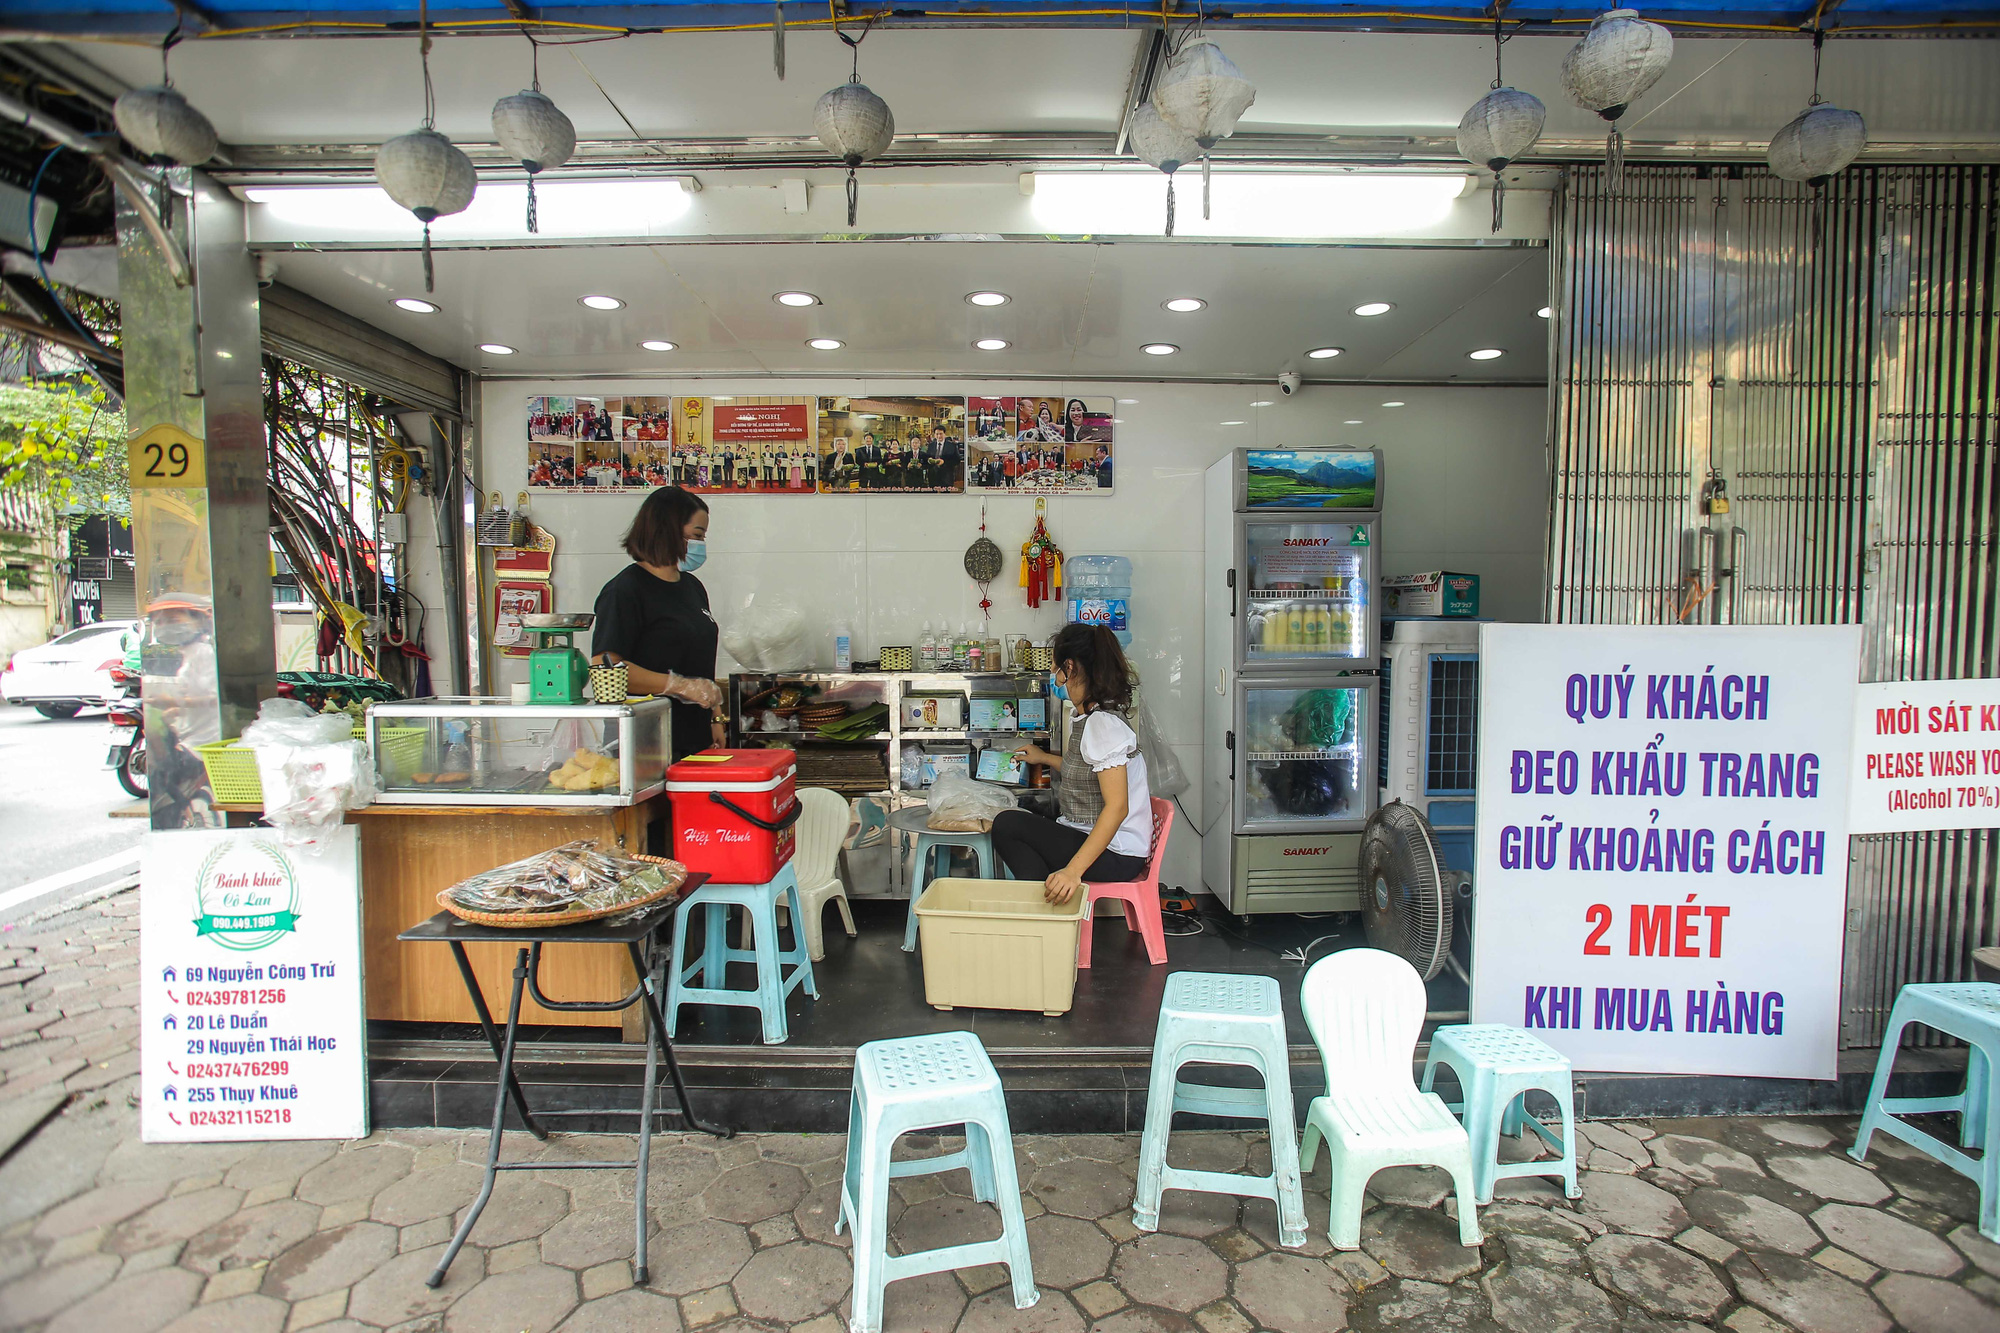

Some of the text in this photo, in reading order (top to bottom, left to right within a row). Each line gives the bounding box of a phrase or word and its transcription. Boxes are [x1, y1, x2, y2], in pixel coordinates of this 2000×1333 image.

[144, 443, 189, 477] 29
[1423, 583, 1438, 592] 400
[80, 602, 94, 623] TÓC
[1566, 665, 1769, 724] QUÝ KHÁCH
[1876, 701, 1919, 735] MỜI
[1928, 700, 1972, 733] SÁT
[1510, 733, 1819, 798] ĐEO KHẨU TRANG
[1867, 752, 1924, 779] PLEASE
[1930, 750, 1976, 776] WASH
[1889, 786, 2000, 813] (Alcohol 70%)
[684, 828, 751, 846] Hiệp Thành
[1500, 809, 1825, 875] GIỮ KHOẢNG CÁCH
[1283, 847, 1330, 855] SANAKY
[214, 872, 282, 889] Bánh khúc
[223, 892, 271, 907] Cô Lan
[212, 915, 275, 929] 090.449.1989
[1584, 894, 1730, 958] 2 MÉT
[186, 961, 335, 983] 69 Nguyễn Công Trứ
[187, 988, 286, 1006] 02439781256
[1525, 981, 1784, 1035] KHI MUA HÀNG
[187, 1010, 268, 1030] 20 Lê Duẩn
[187, 1034, 336, 1055] 29 Nguyễn Thái Học
[187, 1061, 289, 1078] 02437476299
[188, 1084, 298, 1104] 255 Thụy Khuê
[190, 1109, 291, 1126] 02432115218
